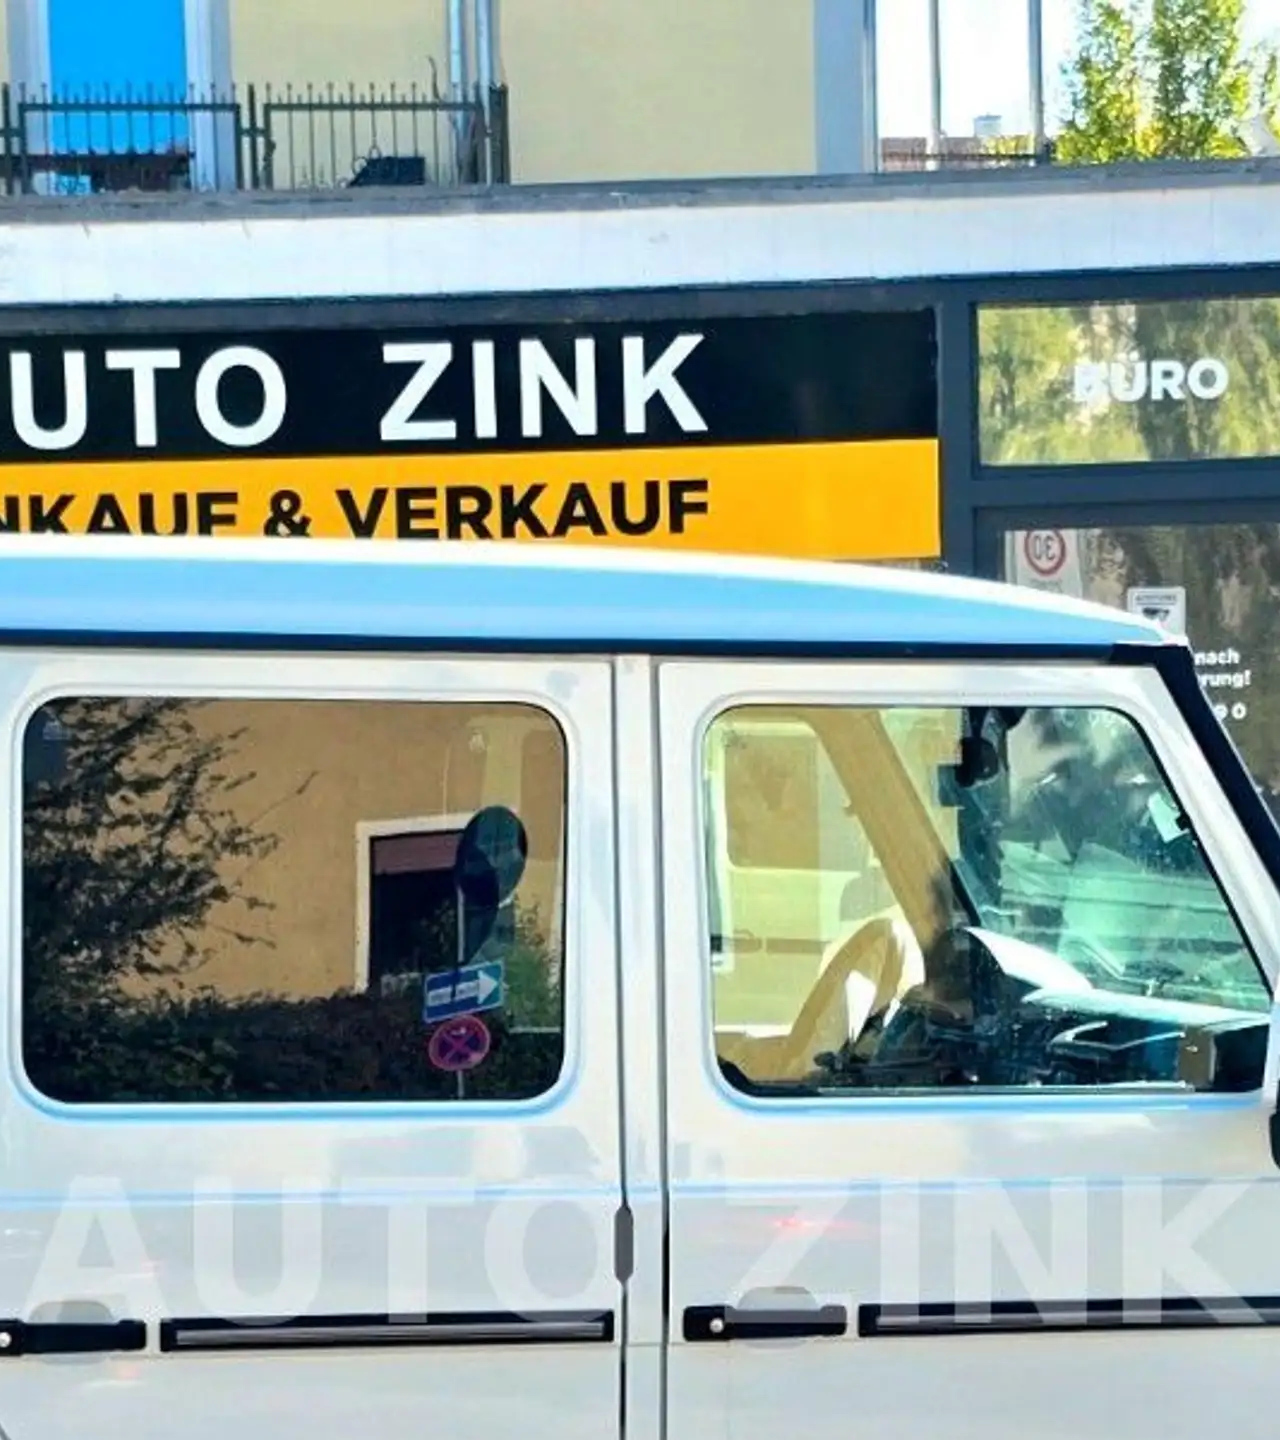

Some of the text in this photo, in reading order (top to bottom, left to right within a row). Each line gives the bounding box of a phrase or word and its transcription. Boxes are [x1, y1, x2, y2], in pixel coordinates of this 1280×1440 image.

[380, 333, 710, 441] ZINK
[1074, 351, 1229, 402] BÜRO
[263, 489, 312, 538] &
[335, 479, 710, 540] VERKAUF
[1197, 670, 1252, 688] rung!
